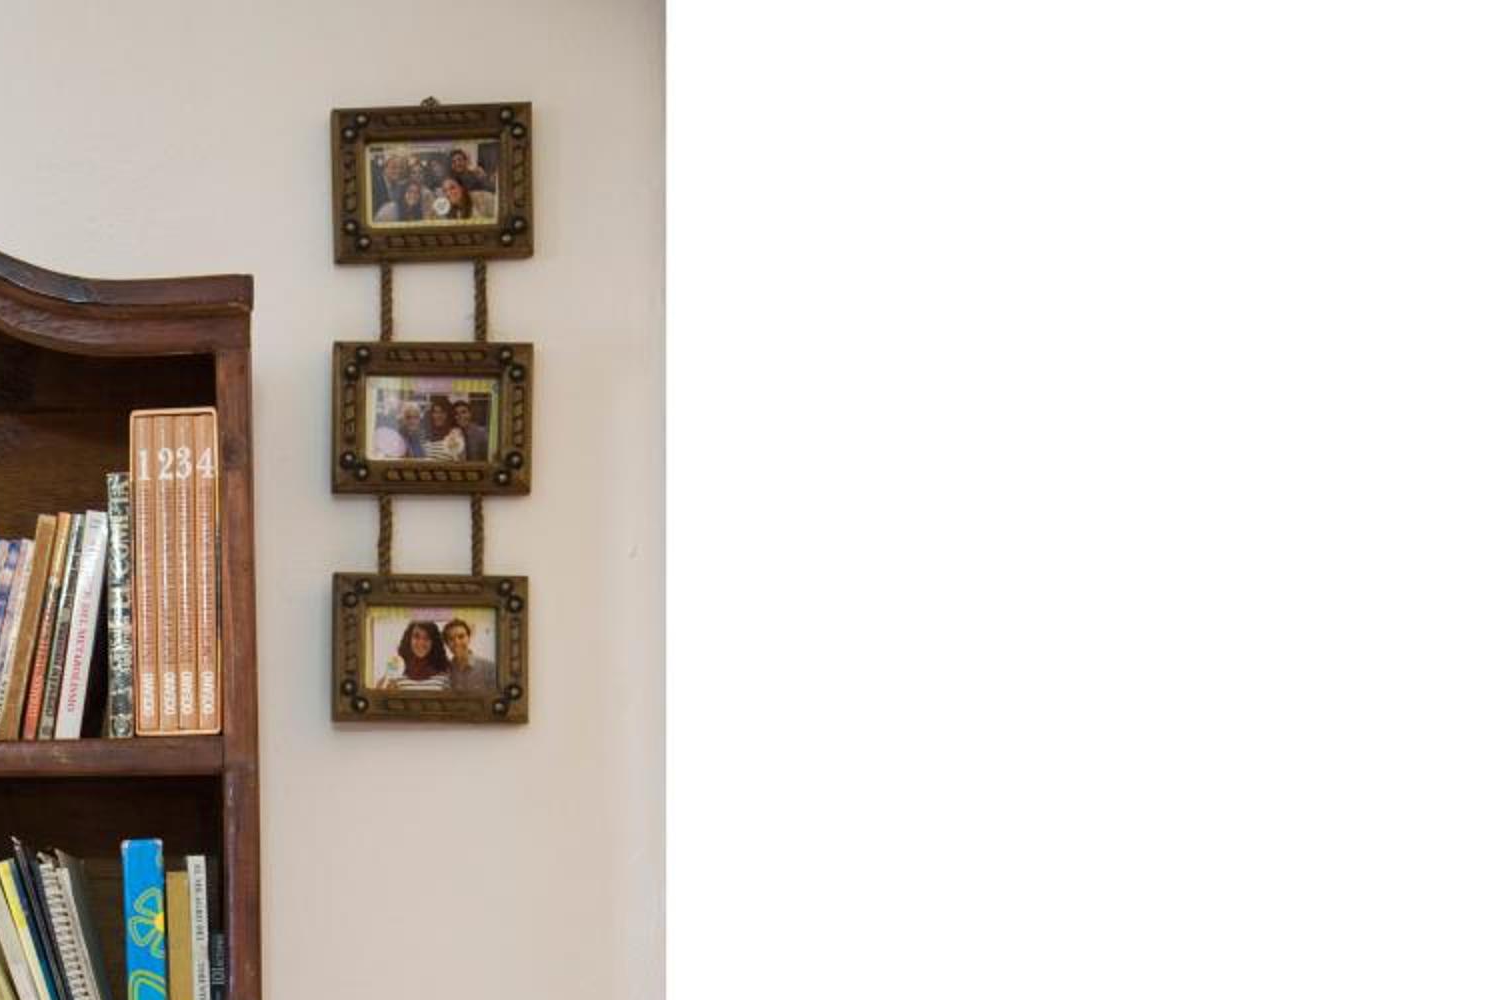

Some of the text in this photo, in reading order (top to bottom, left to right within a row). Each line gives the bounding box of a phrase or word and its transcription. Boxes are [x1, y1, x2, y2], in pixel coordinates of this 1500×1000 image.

[137, 448, 151, 481] 1
[158, 448, 174, 479] 2
[176, 446, 193, 479] 3
[196, 447, 215, 479] 4
